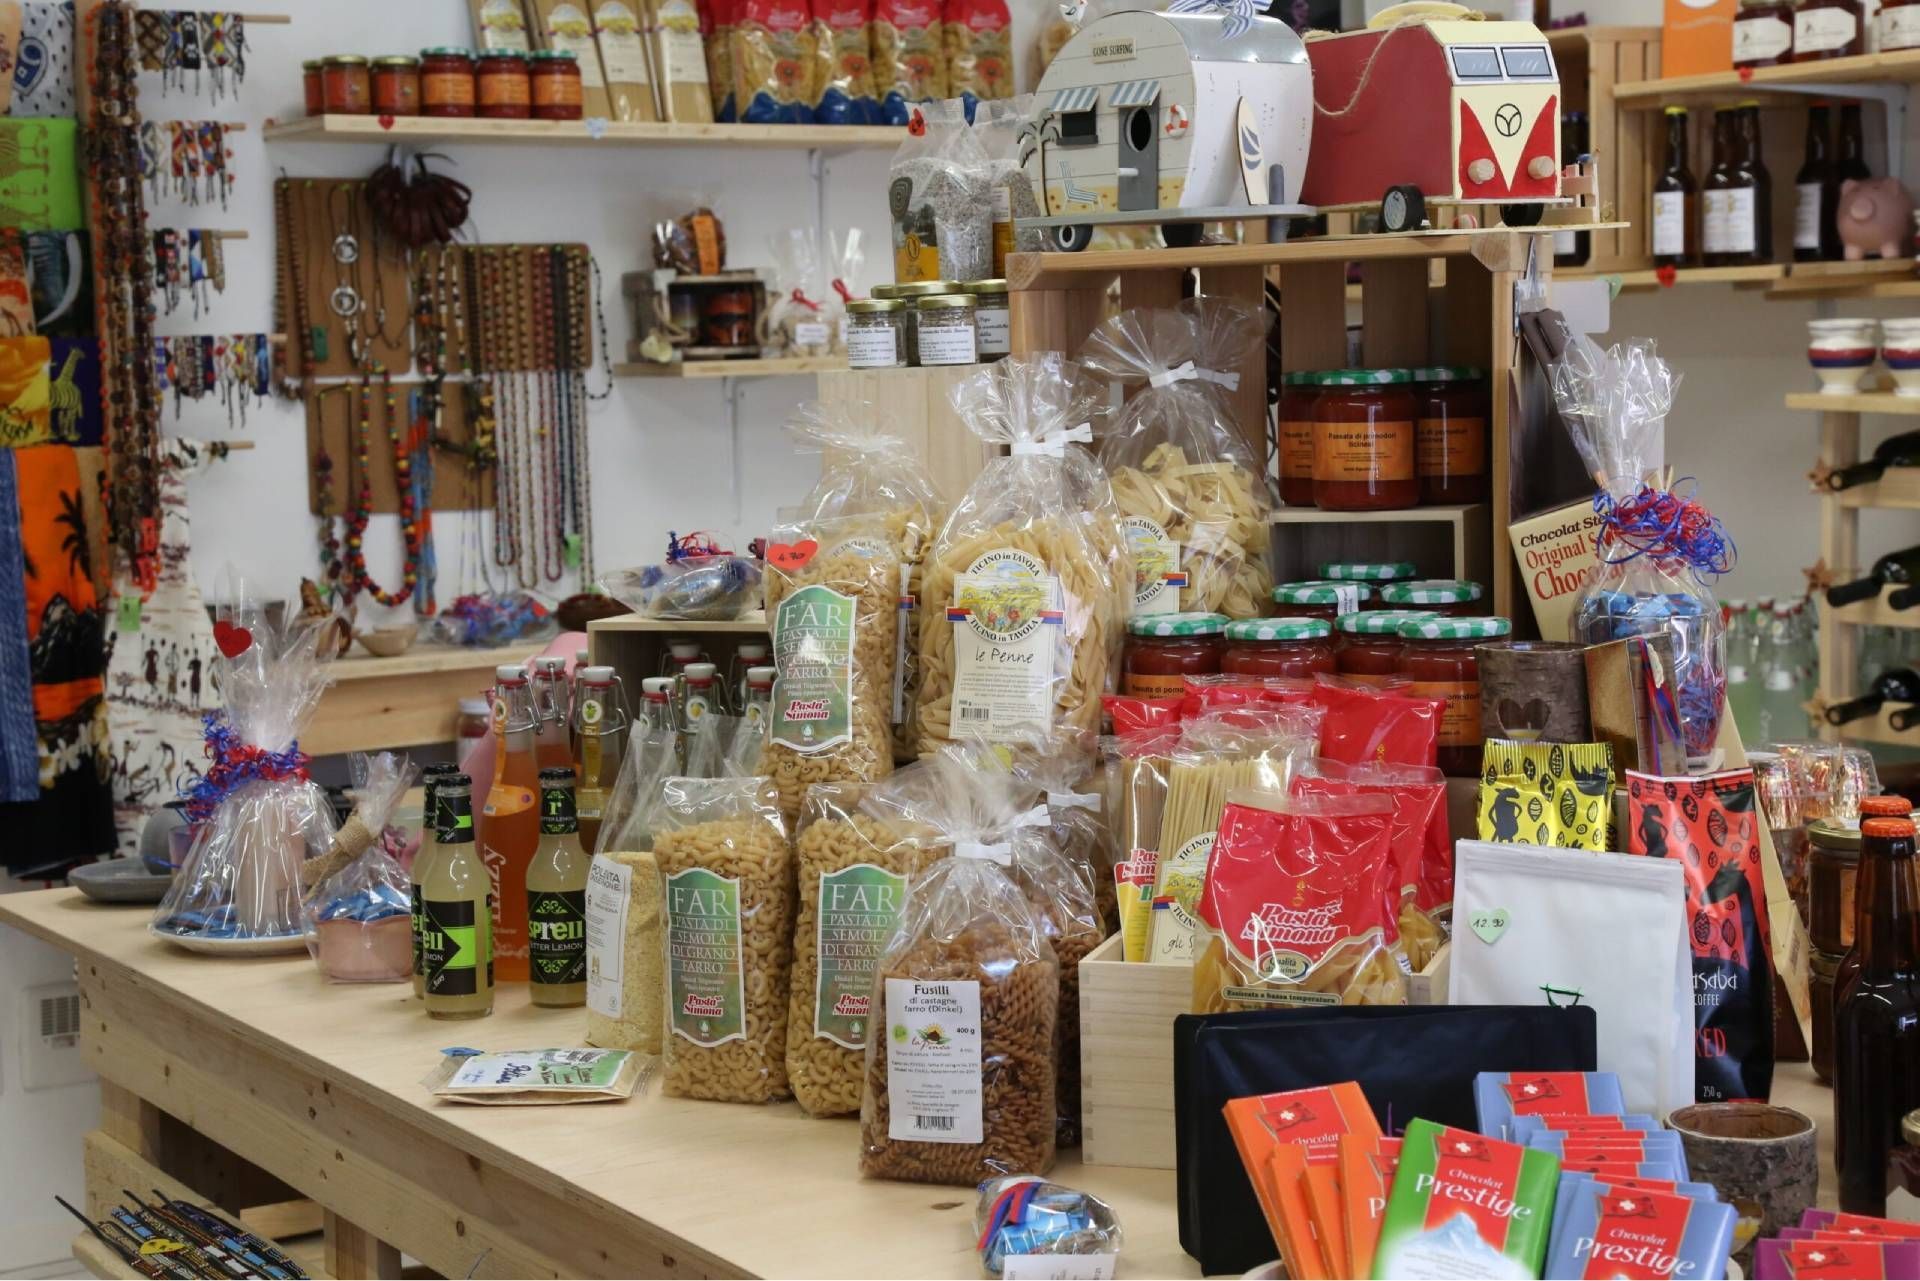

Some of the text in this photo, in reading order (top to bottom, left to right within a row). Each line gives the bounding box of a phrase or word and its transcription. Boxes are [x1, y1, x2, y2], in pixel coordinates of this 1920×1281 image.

[1092, 43, 1133, 57] GONE SURFING
[1354, 432, 1362, 441] di
[1139, 519, 1164, 542] TAVOLA
[1520, 520, 1582, 549] Chocolat
[1525, 534, 1587, 569] Original
[971, 551, 1040, 577] TICINO in TAVOLA
[1136, 581, 1164, 604] TAVOLA
[783, 603, 847, 629] FAR
[782, 627, 819, 641] PASTA
[970, 617, 997, 641] TICINO
[1009, 619, 1039, 641] TAVOLA
[991, 647, 1034, 664] Penne
[786, 666, 833, 679] FARRO
[1163, 686, 1184, 695] pomo
[790, 700, 823, 711] Pasta
[784, 711, 829, 720] Simona
[1179, 837, 1210, 861] TICINO
[1132, 850, 1159, 864] Pas
[674, 888, 731, 916] FAR
[831, 885, 896, 912] FAR
[830, 914, 869, 926] PASTA
[1259, 903, 1330, 929] Pasta
[676, 916, 729, 931] PASTA DI
[1241, 917, 1336, 944] Simona
[678, 933, 728, 945] SEMOLA
[532, 942, 583, 951] ITTER LEMON
[839, 944, 881, 956] GRAN
[686, 948, 736, 960] GRANO
[682, 960, 724, 974] FARRO
[914, 984, 950, 995] Fusilli
[688, 995, 717, 1007] Pasta
[920, 998, 957, 1006] castagne
[1289, 993, 1336, 1004] temperatura
[684, 1006, 723, 1016] Simona
[835, 1005, 870, 1015] Simon
[904, 1005, 963, 1014] farro (Dinkel)
[1703, 1085, 1715, 1097] 250
[1449, 1168, 1504, 1190] Chocolat
[1415, 1172, 1532, 1220] Prestige
[1609, 1227, 1667, 1246] Chocolat
[1572, 1236, 1696, 1276] Prestige
